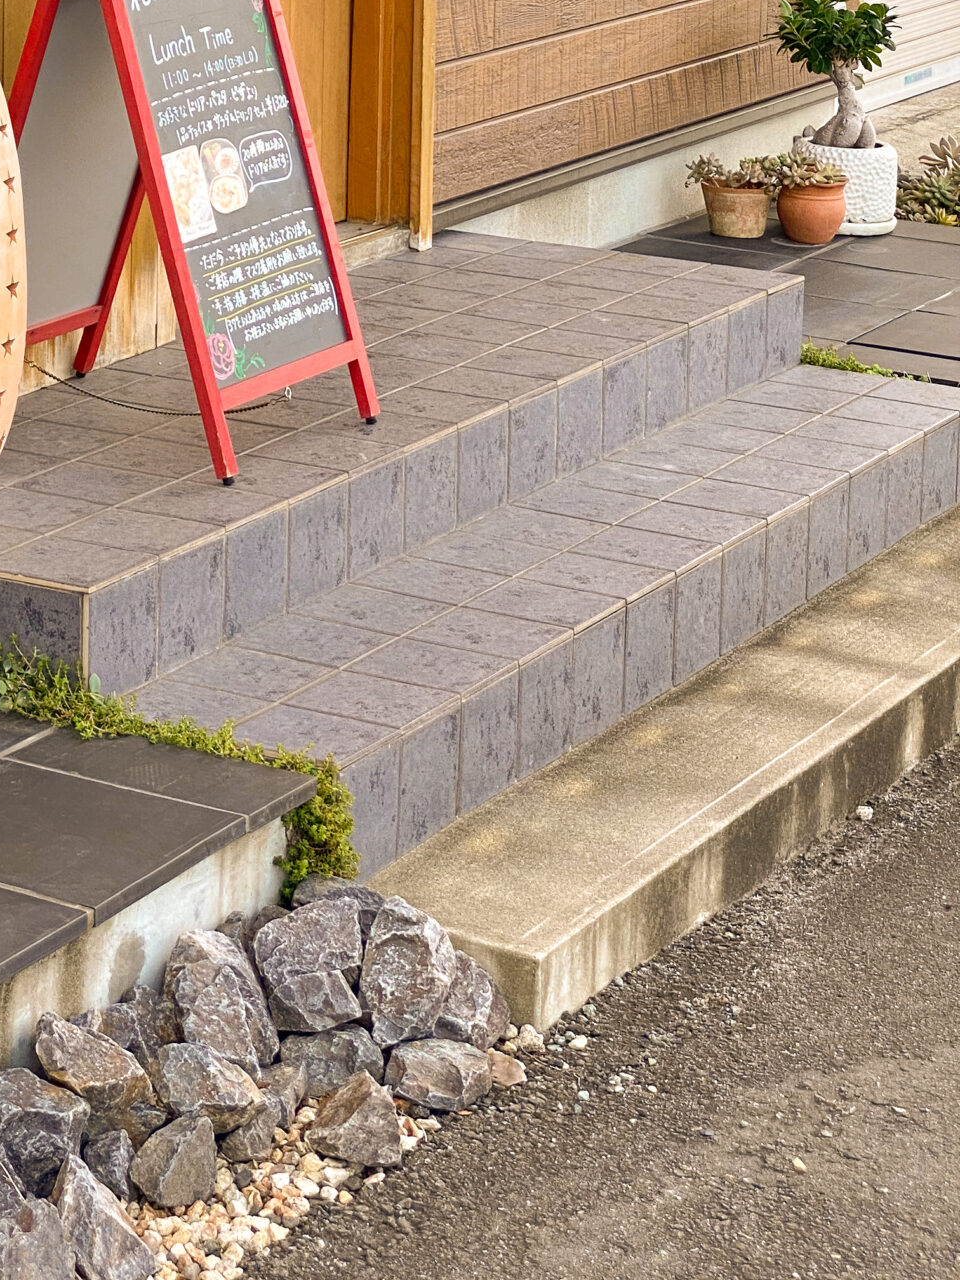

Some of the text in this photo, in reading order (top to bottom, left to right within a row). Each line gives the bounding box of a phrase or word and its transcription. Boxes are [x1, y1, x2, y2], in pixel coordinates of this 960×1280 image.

[149, 25, 234, 65] Lunch Time
[162, 69, 189, 90] 11:00
